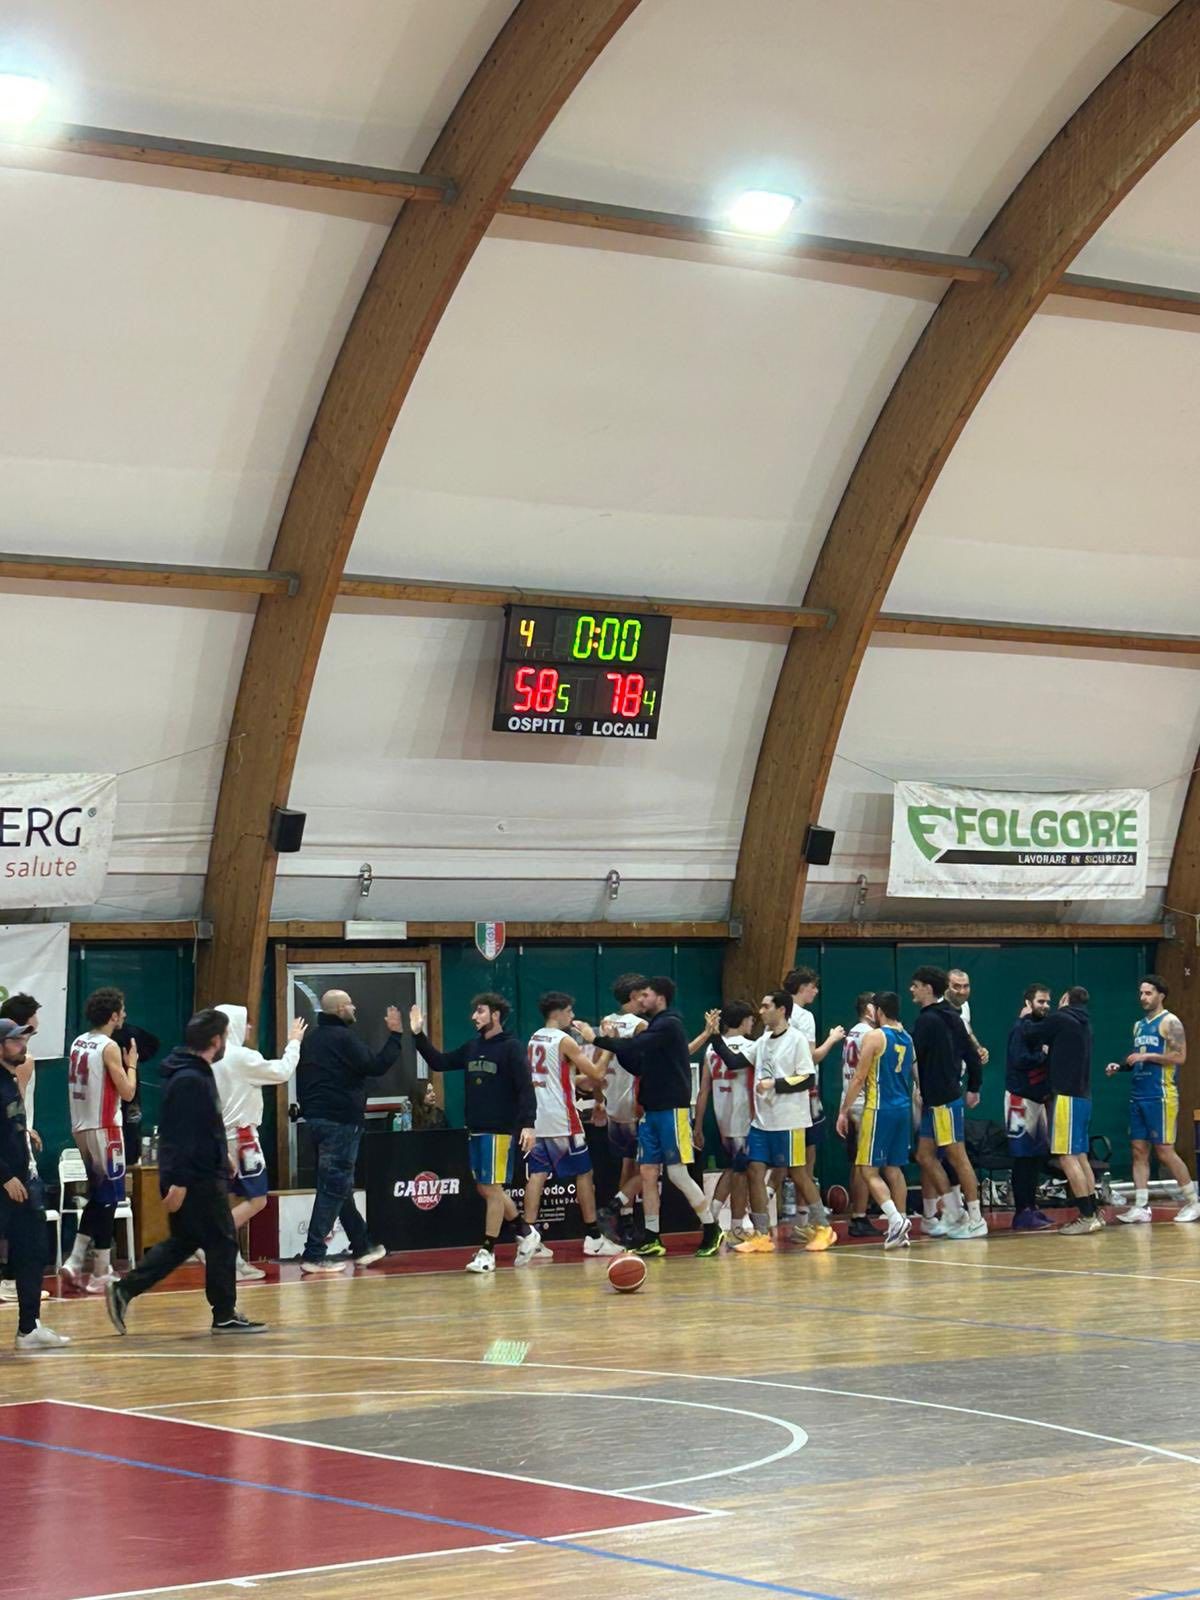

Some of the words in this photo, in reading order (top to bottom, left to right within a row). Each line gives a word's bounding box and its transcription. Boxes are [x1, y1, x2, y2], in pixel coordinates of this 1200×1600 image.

[519, 619, 535, 648] 4
[572, 615, 641, 662] 0:00
[513, 665, 559, 712] 58
[555, 684, 571, 713] 5
[606, 672, 645, 718] 78
[643, 690, 657, 716] 4
[507, 716, 566, 733] OSPITI
[592, 721, 650, 737] LOCALI
[955, 807, 1138, 848] FOLGORE
[5, 855, 77, 877] salute
[1018, 854, 1067, 865] LAVORARE
[1071, 855, 1081, 865] IN
[1084, 854, 1135, 865] SICUREZZA
[69, 1049, 90, 1086] 14
[894, 1043, 907, 1073] 7
[393, 1178, 460, 1197] CARVER
